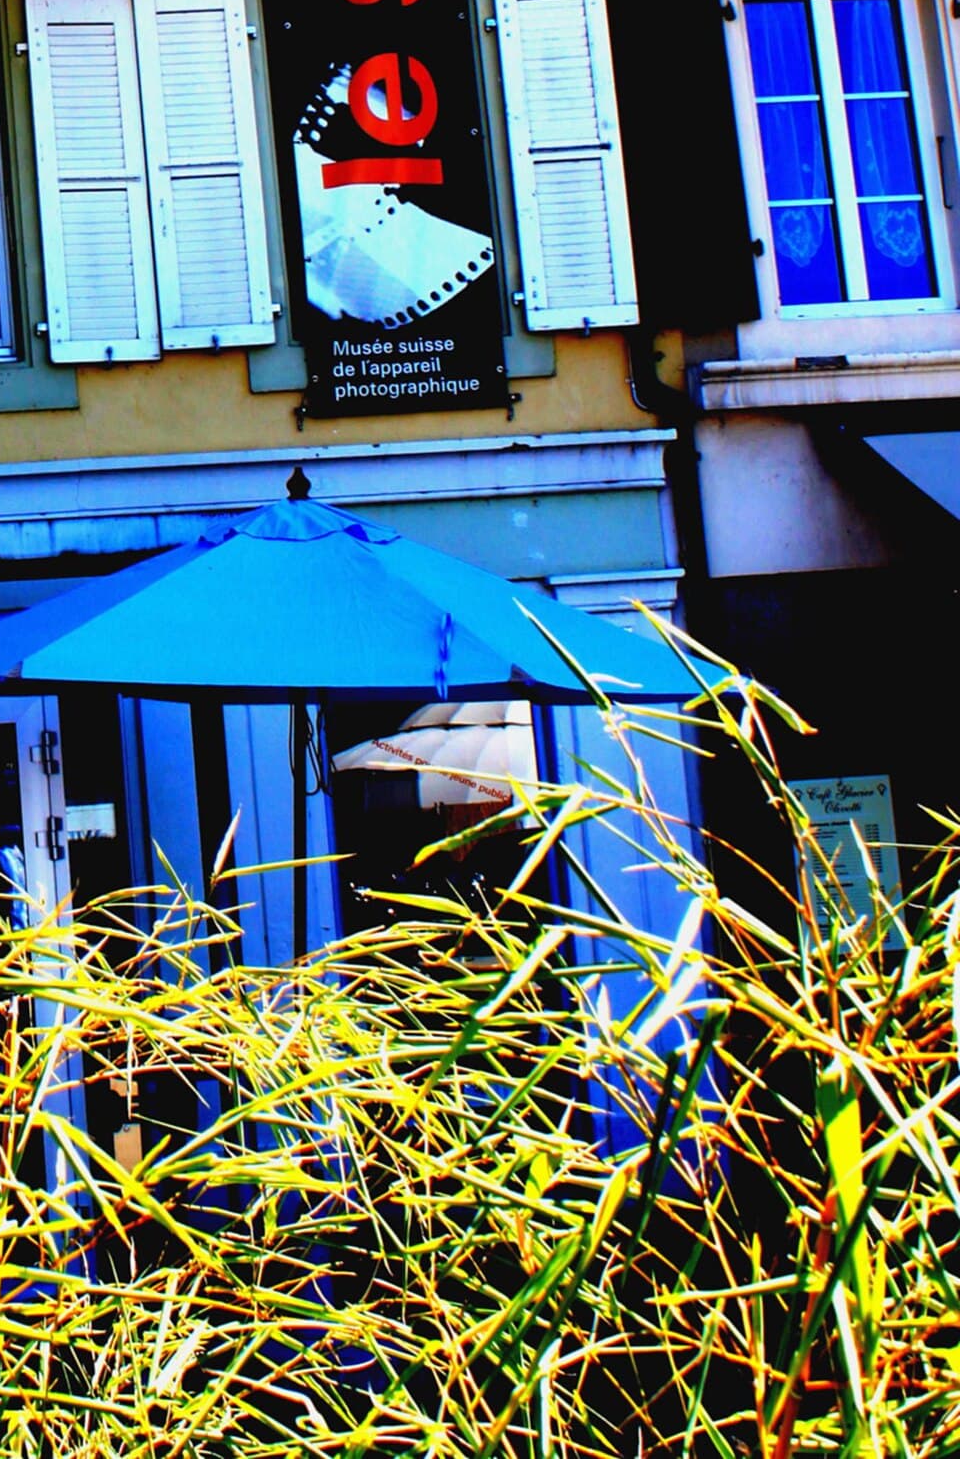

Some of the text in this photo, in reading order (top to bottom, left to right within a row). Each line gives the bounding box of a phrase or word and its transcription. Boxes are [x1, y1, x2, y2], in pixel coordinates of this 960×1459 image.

[321, 52, 444, 189] le
[332, 337, 455, 357] Musée suisse
[332, 361, 356, 378] de
[334, 376, 480, 401] photographique
